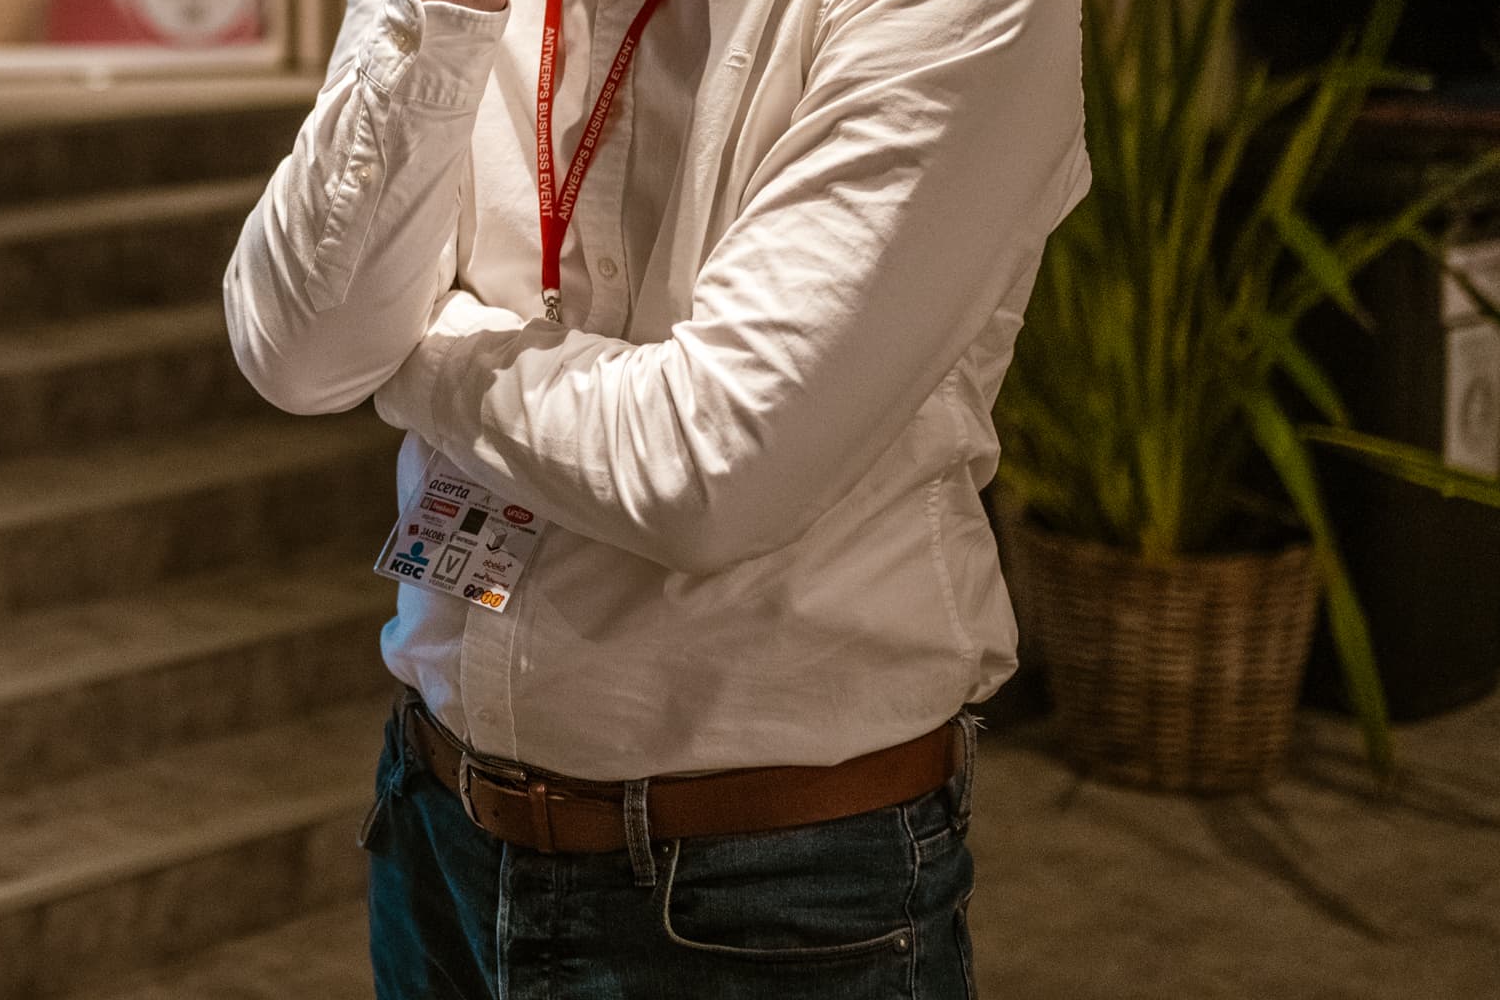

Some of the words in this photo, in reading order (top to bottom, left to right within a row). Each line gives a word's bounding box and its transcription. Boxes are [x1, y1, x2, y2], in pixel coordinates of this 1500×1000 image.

[538, 26, 556, 99] ANTWERPS
[538, 103, 550, 170] BUSINESS
[558, 150, 590, 221] ANTWERPS
[583, 81, 616, 147] BUSINESS
[610, 35, 636, 81] EVENT
[539, 174, 553, 219] EVENT
[429, 478, 471, 500] acerta
[506, 508, 531, 522] unizo
[420, 526, 447, 543] JACOBS
[389, 558, 426, 581] KBC
